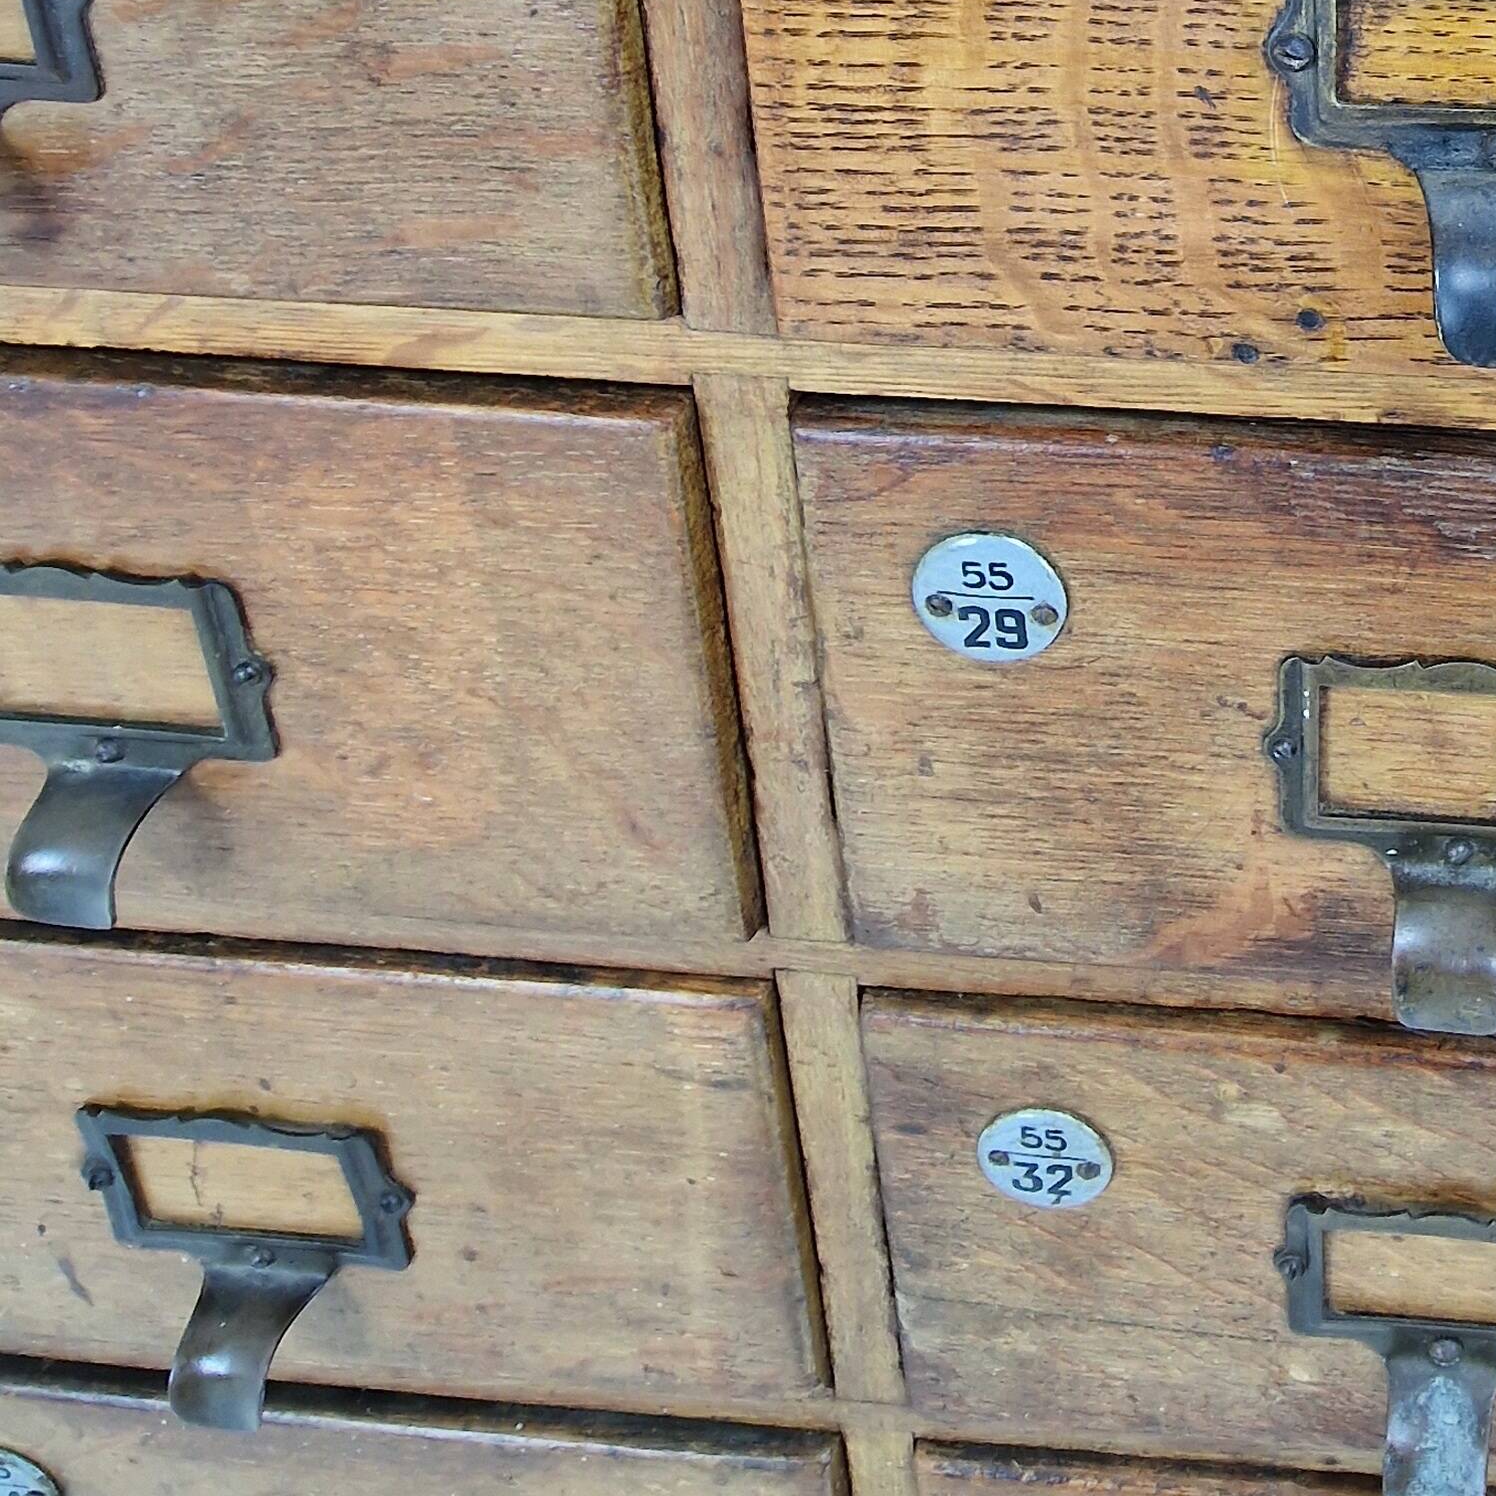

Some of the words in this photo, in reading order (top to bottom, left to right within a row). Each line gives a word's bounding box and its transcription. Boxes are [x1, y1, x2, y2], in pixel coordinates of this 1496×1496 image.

[961, 561, 1014, 591] 55
[957, 605, 1029, 649] 29
[1020, 1125, 1068, 1152] 55
[1011, 1160, 1074, 1197] 32
